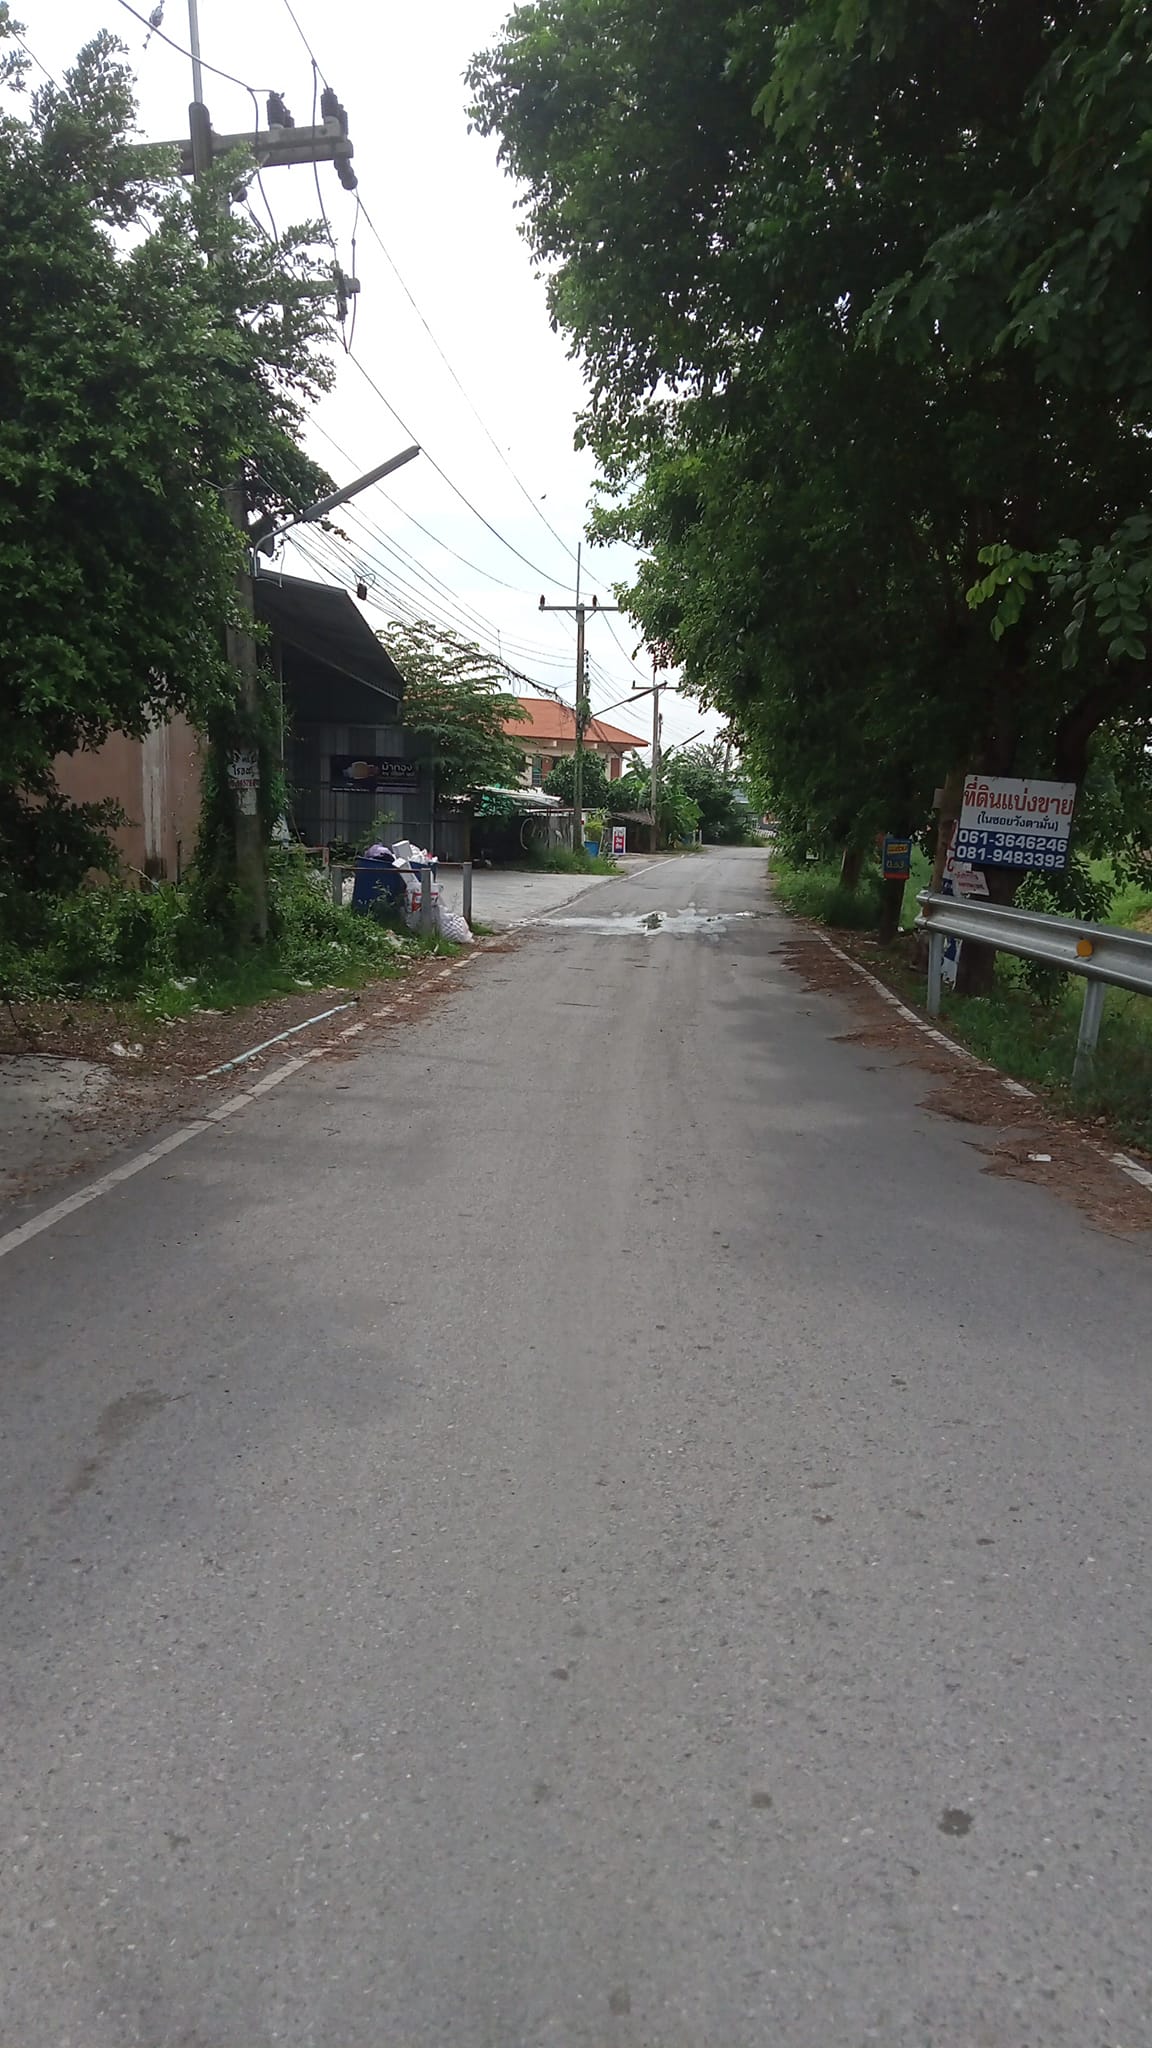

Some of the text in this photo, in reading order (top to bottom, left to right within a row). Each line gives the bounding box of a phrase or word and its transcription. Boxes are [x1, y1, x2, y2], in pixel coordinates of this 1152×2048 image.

[964, 779, 1074, 816] ที่ดินแบ่งขาย
[958, 830, 1068, 852] 061-3646246
[956, 845, 1065, 868] 081-9483392
